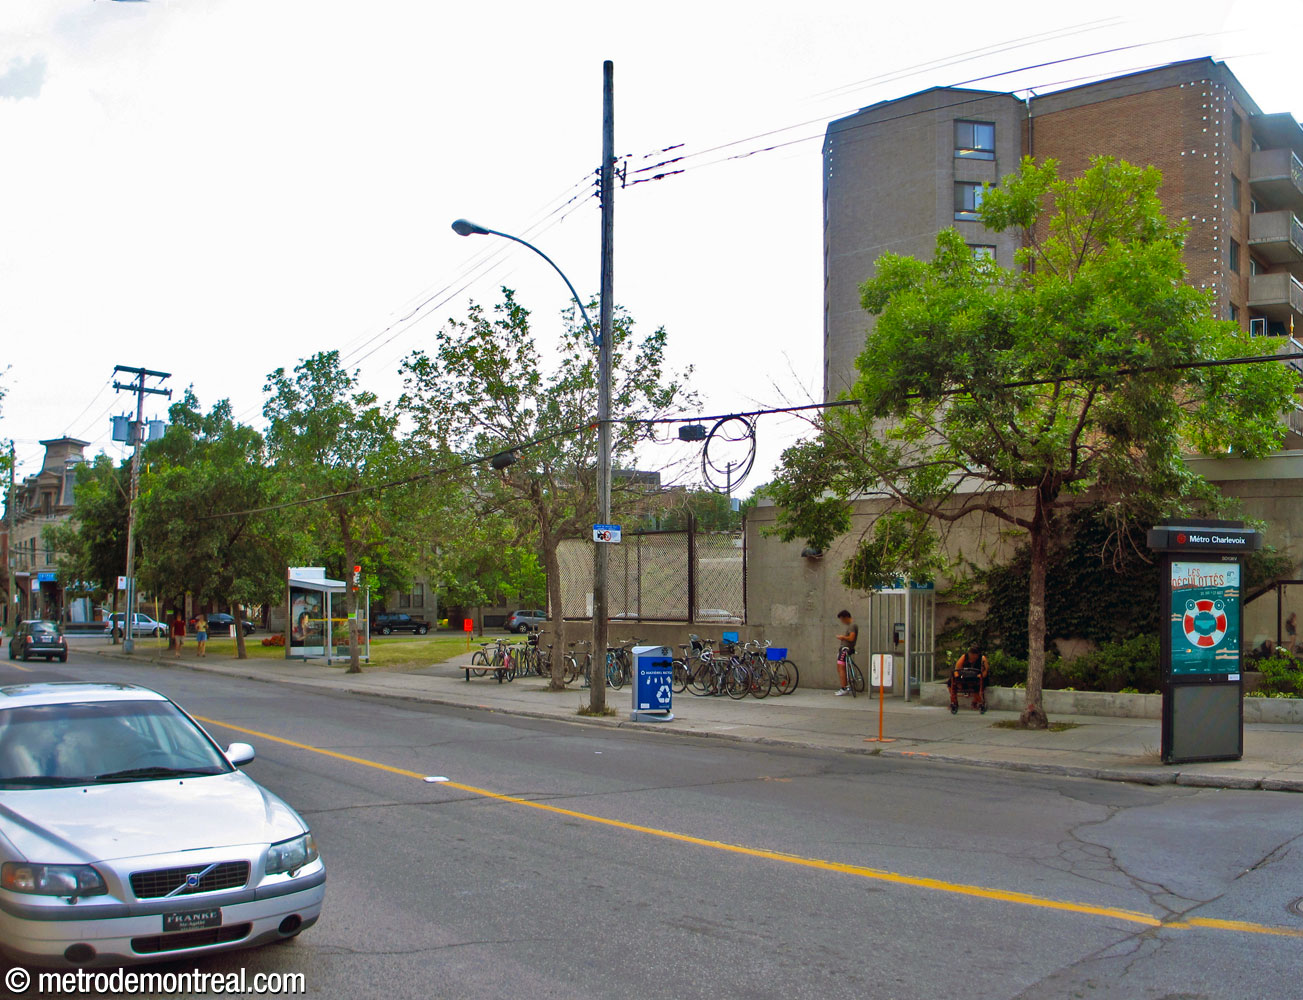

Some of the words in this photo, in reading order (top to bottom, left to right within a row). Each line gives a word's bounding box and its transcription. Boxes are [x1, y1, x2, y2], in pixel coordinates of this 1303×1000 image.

[1189, 535, 1210, 543] Métro
[1211, 536, 1246, 544] Charlevoix
[1187, 568, 1200, 577] LES
[1171, 572, 1225, 590] DÉCULOTTÉS
[168, 911, 218, 923] FRANKE
